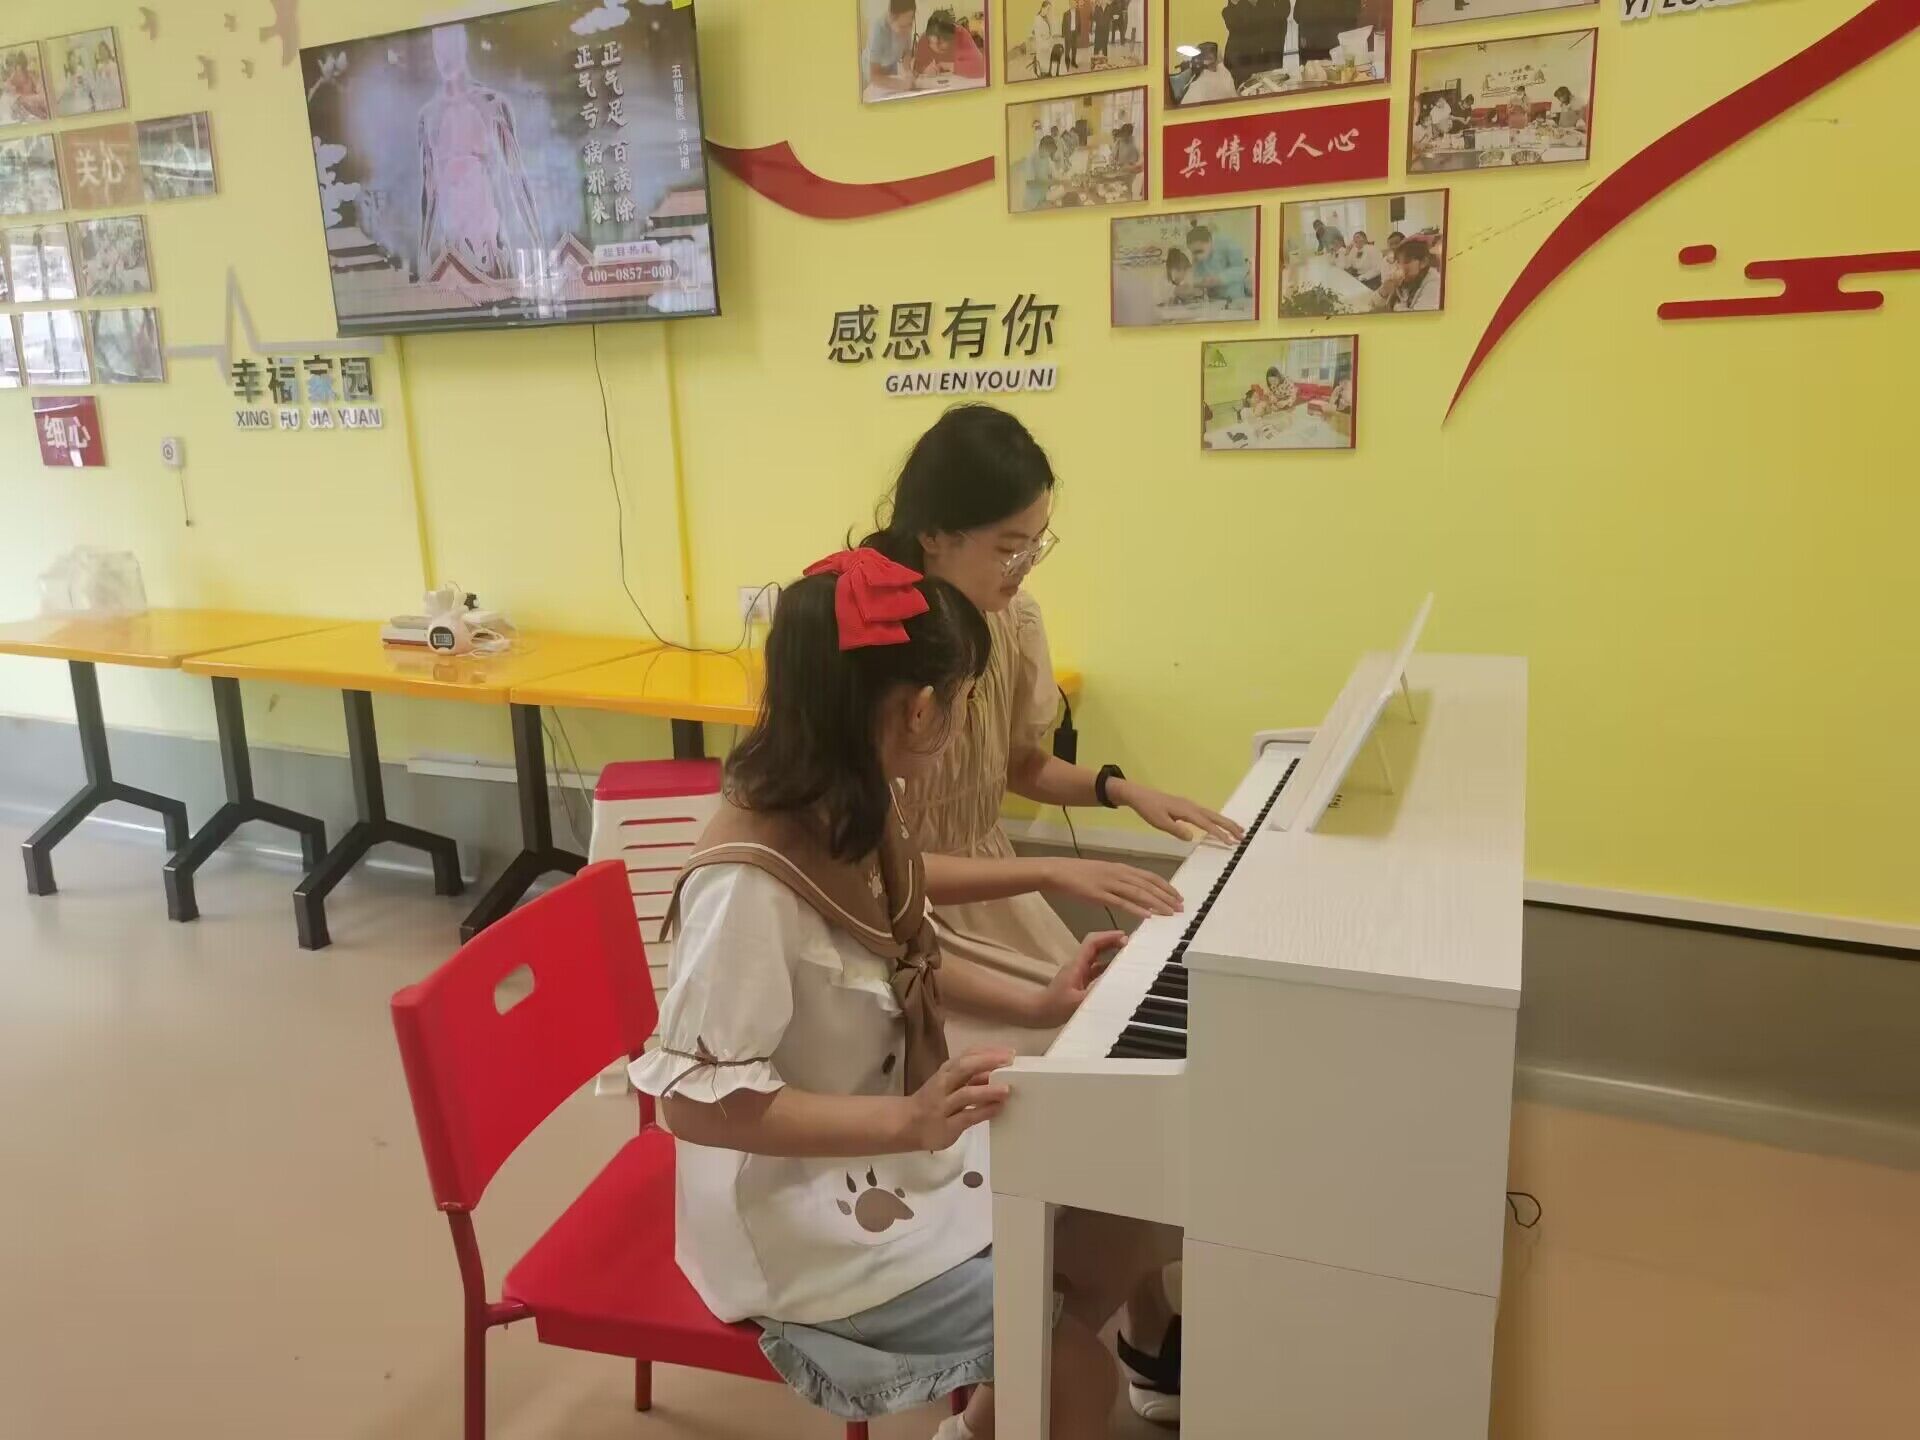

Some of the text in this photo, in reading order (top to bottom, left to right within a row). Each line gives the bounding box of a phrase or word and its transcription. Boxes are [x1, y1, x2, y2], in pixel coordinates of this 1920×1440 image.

[574, 43, 599, 129] 正气亏
[601, 40, 636, 222] 正气足 百病除
[1179, 127, 1360, 179] 真情暖人心
[75, 138, 126, 187] 关心
[587, 263, 672, 282] 400-0857-000
[828, 293, 1060, 364] 感恩有你
[231, 354, 373, 404] 幸福家园
[885, 367, 1054, 393] GAN EN YOU NI
[43, 414, 91, 449] 细心
[236, 408, 381, 427] XING FU JIA YUAN
